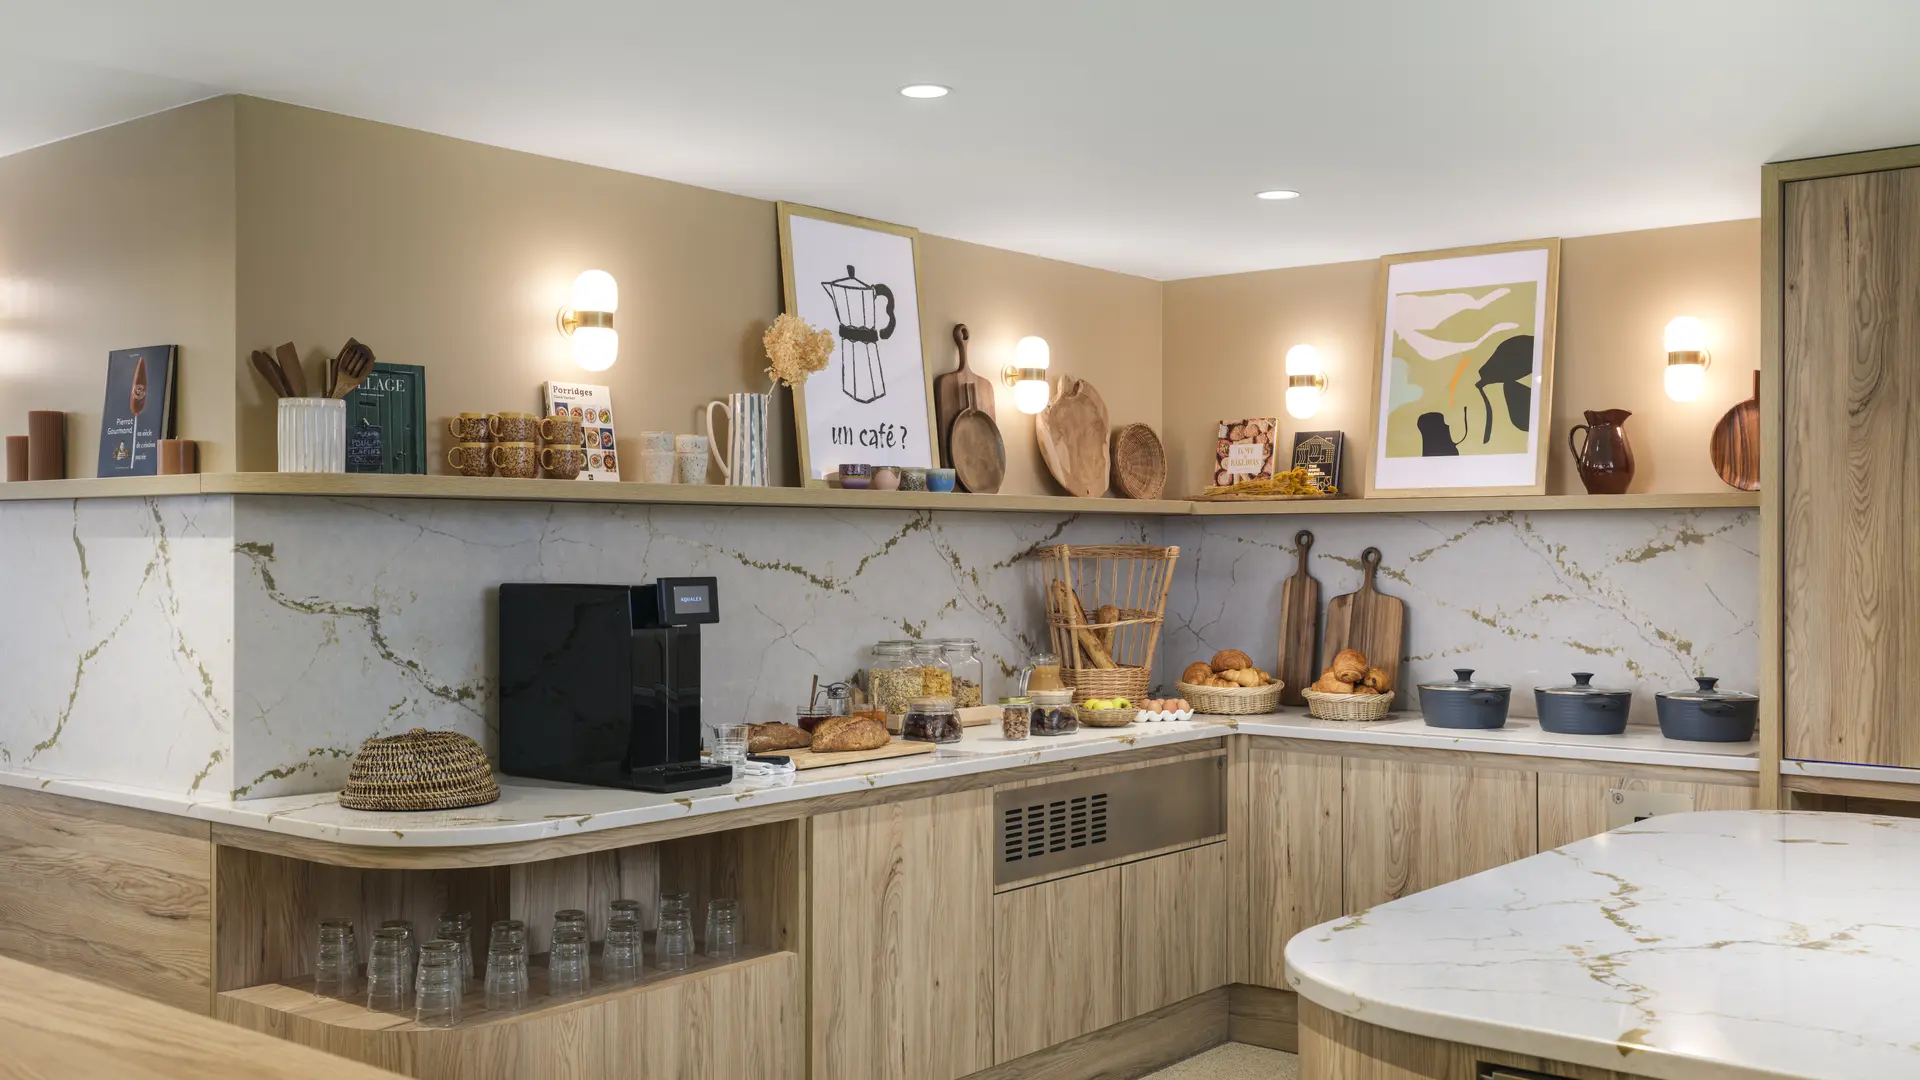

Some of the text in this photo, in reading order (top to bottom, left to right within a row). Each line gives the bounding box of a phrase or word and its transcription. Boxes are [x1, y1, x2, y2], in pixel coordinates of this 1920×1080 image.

[553, 385, 593, 397] Porridges
[116, 417, 133, 425] Pierrot
[107, 427, 132, 435] Gourmand
[832, 422, 907, 449] un café ?
